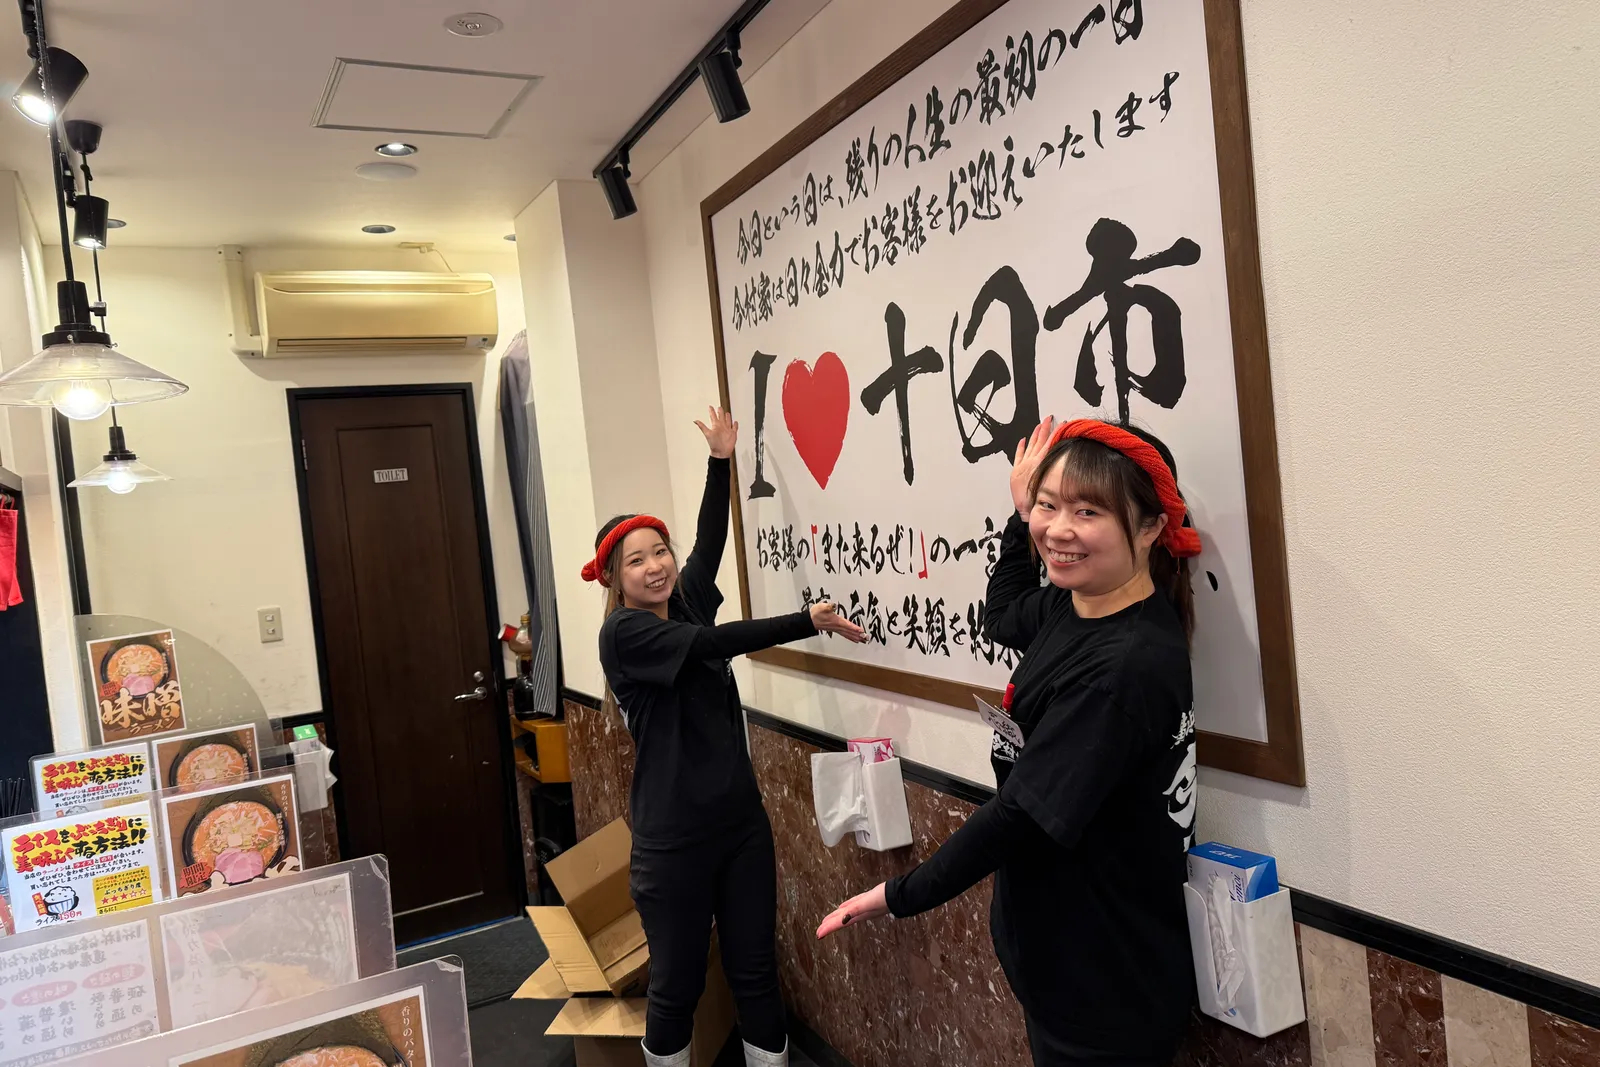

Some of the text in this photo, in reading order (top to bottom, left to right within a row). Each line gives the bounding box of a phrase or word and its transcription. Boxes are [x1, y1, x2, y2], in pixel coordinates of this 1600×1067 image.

[376, 469, 406, 482] TOILET
[100, 680, 181, 728] 味噌
[130, 717, 176, 735] ラーメン
[13, 815, 143, 853] ライスをぶっちぎりに
[14, 828, 147, 874] 美味しくする方法!!
[183, 862, 205, 876] 期間
[185, 872, 208, 886] 限定
